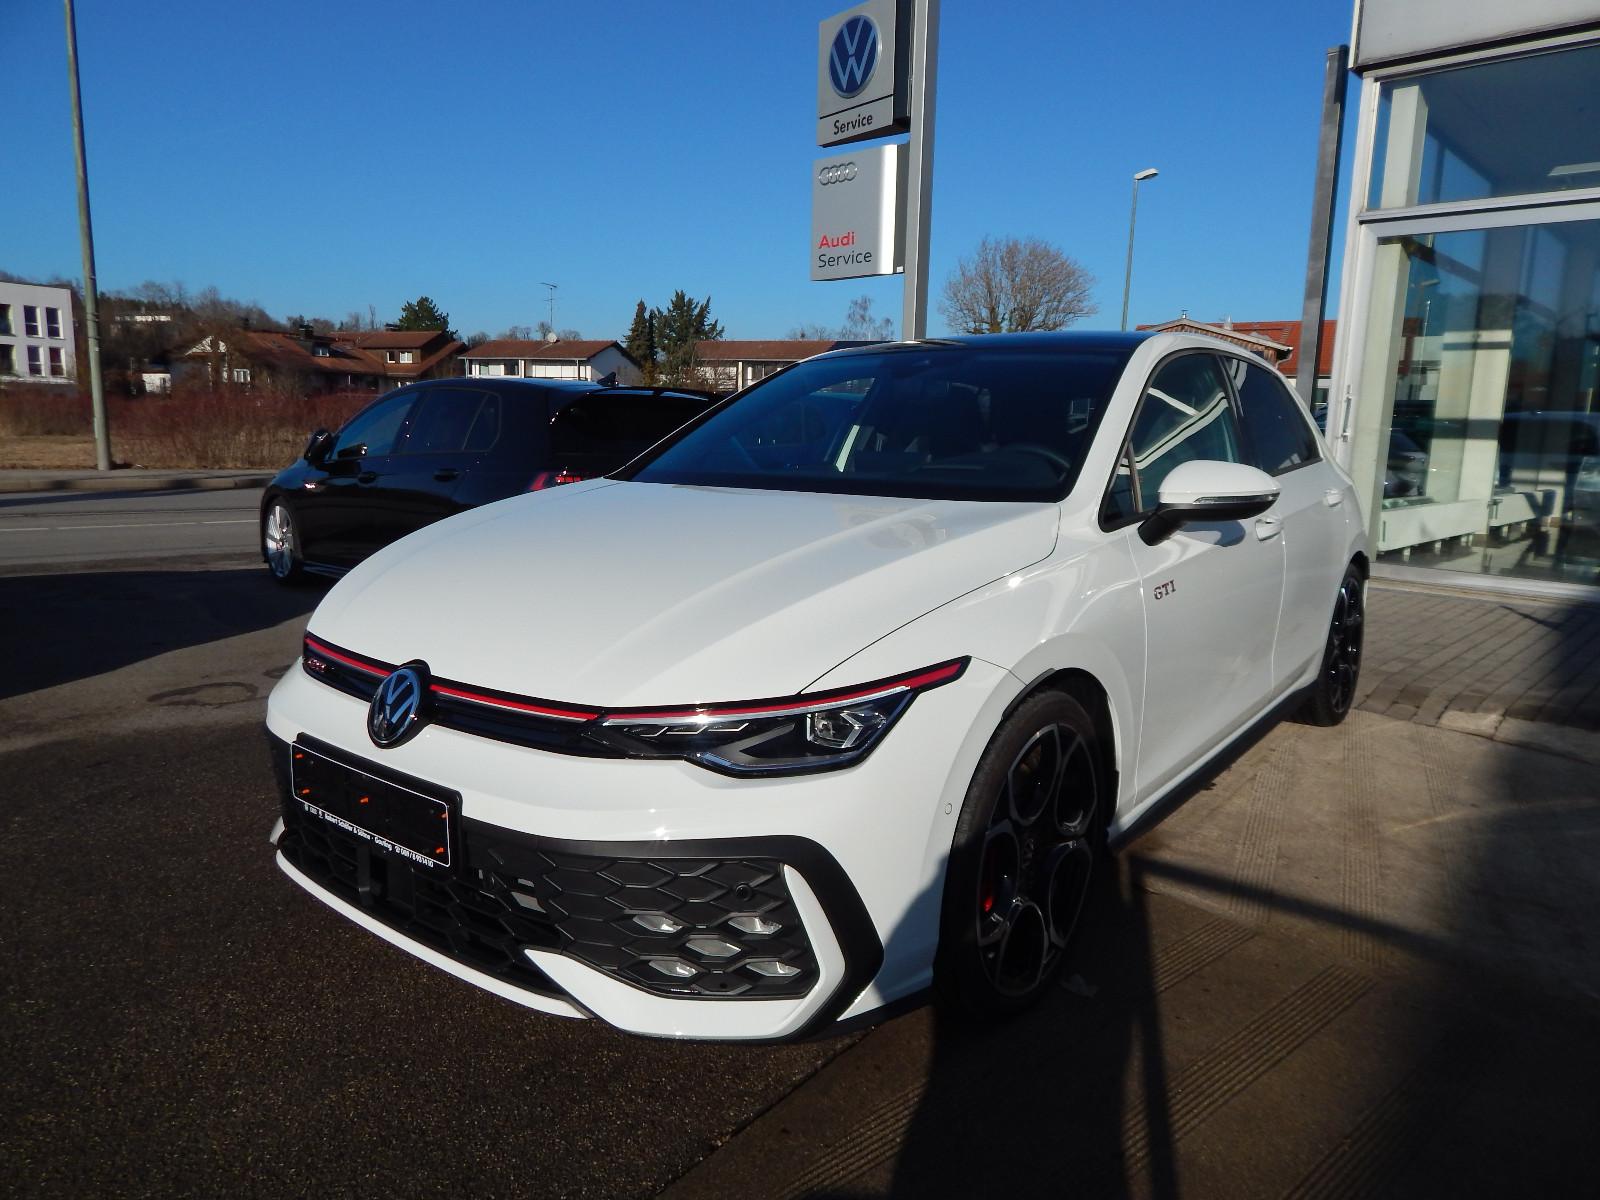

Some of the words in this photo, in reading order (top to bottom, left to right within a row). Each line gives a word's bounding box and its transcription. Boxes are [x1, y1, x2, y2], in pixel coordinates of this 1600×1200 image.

[830, 17, 877, 95] VW
[833, 114, 873, 135] Service
[819, 231, 855, 249] Audi
[818, 250, 872, 268] Service
[1153, 579, 1176, 600] GTI
